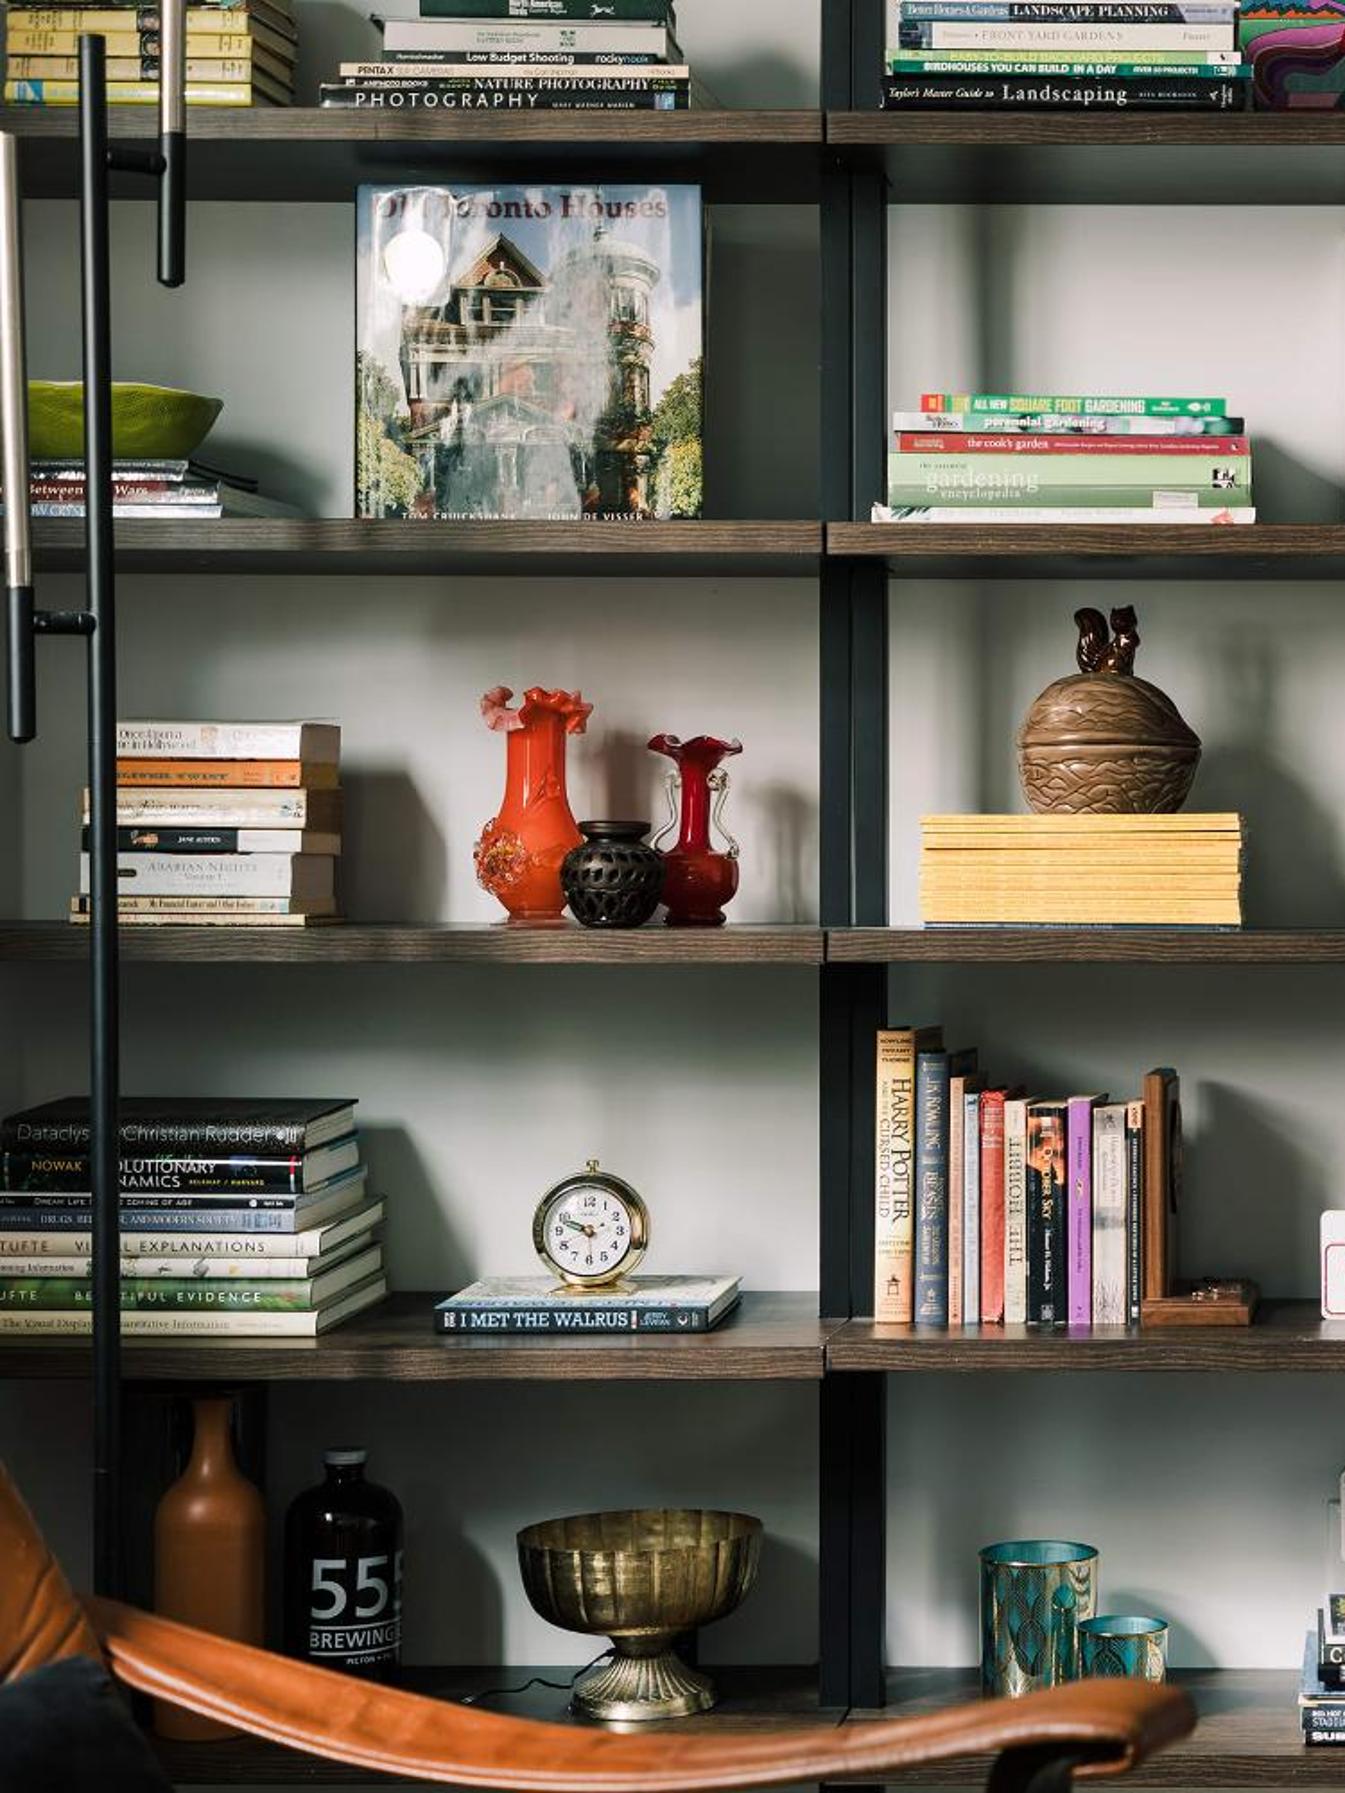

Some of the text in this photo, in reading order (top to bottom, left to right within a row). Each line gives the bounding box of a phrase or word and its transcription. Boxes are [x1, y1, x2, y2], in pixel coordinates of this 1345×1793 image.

[1013, 4, 1093, 17] LANDSCAPE
[1098, 4, 1169, 17] PLANNING
[1027, 30, 1059, 41] YARD
[1062, 30, 1124, 42] GARDENS
[466, 52, 575, 65] Low Budget Shooting
[357, 66, 394, 75] PENTAX
[923, 62, 1118, 74] BIRDHOUSES YOU CAN BUILD IN A DAY
[474, 78, 534, 91] NATURE
[538, 78, 648, 91] PHOTOGRAPHY
[356, 92, 540, 108] PHOTOGRAPHY
[1001, 83, 1128, 106] Landscaping
[558, 193, 667, 220] Houses
[974, 397, 1146, 414] ALL NEW SQUARE FOOT GARDENING
[984, 415, 1105, 431] perennial gardening
[967, 438, 983, 448] the
[983, 438, 1014, 448] cook's
[1014, 438, 1049, 451] garden
[927, 469, 1039, 493] gardening
[114, 484, 148, 496] Wars
[939, 487, 1022, 500] encyclopedia
[401, 511, 430, 520] TOM
[144, 860, 258, 873] ARABIAN NIGHTS
[121, 1125, 271, 1143] Christian Rudder
[889, 1077, 912, 1225] HARRY POTTER
[31, 1160, 83, 1172] NOWAK
[878, 1117, 890, 1218] CURSED CHILD
[1040, 1147, 1055, 1220] OCTOBER SKY
[583, 1195, 597, 1208] 12
[1008, 1136, 1023, 1266] THE HOBBIT
[40, 1214, 73, 1225] DRUGS
[611, 1210, 621, 1222] 2
[554, 1225, 564, 1237] 9
[615, 1225, 625, 1237] 3
[0, 1240, 266, 1253] TUFTE EXPLANATIONS
[558, 1240, 570, 1252] 8
[609, 1239, 619, 1251] 4
[569, 1250, 578, 1262] 7
[584, 1253, 594, 1266] 6
[599, 1250, 610, 1262] 5
[176, 1291, 263, 1304] EVIDENCE
[460, 1311, 629, 1328] I MET THE WALRUS
[309, 1626, 395, 1649] BREWING
[1326, 1710, 1342, 1718] HOT
